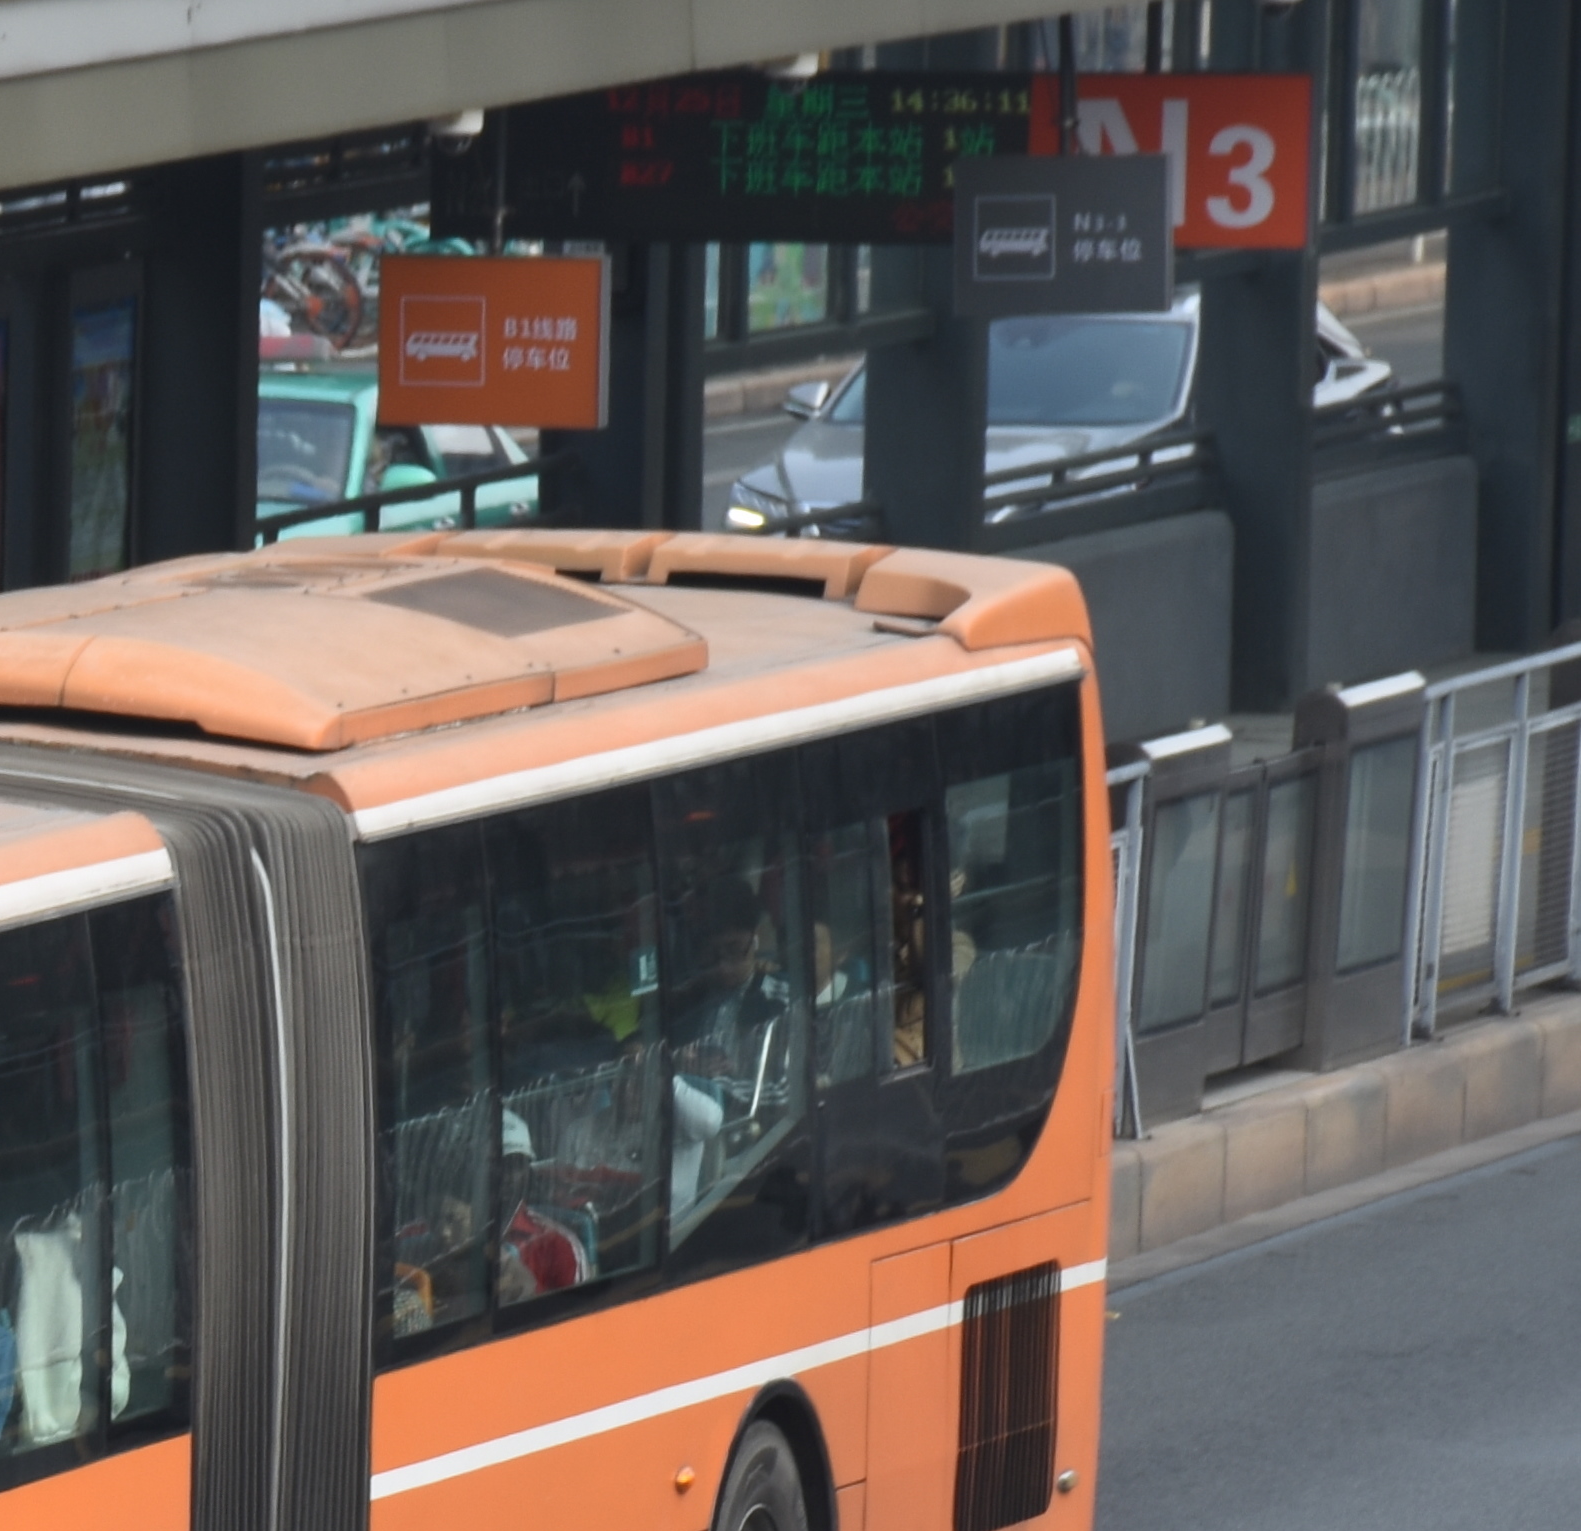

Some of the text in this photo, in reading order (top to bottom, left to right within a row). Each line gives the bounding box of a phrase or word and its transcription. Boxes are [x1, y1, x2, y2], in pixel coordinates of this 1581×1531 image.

[890, 87, 1030, 114] 14:36:11
[1073, 237, 1142, 262] 停车位
[503, 317, 578, 342] B1线路
[502, 347, 570, 371] 停车位
